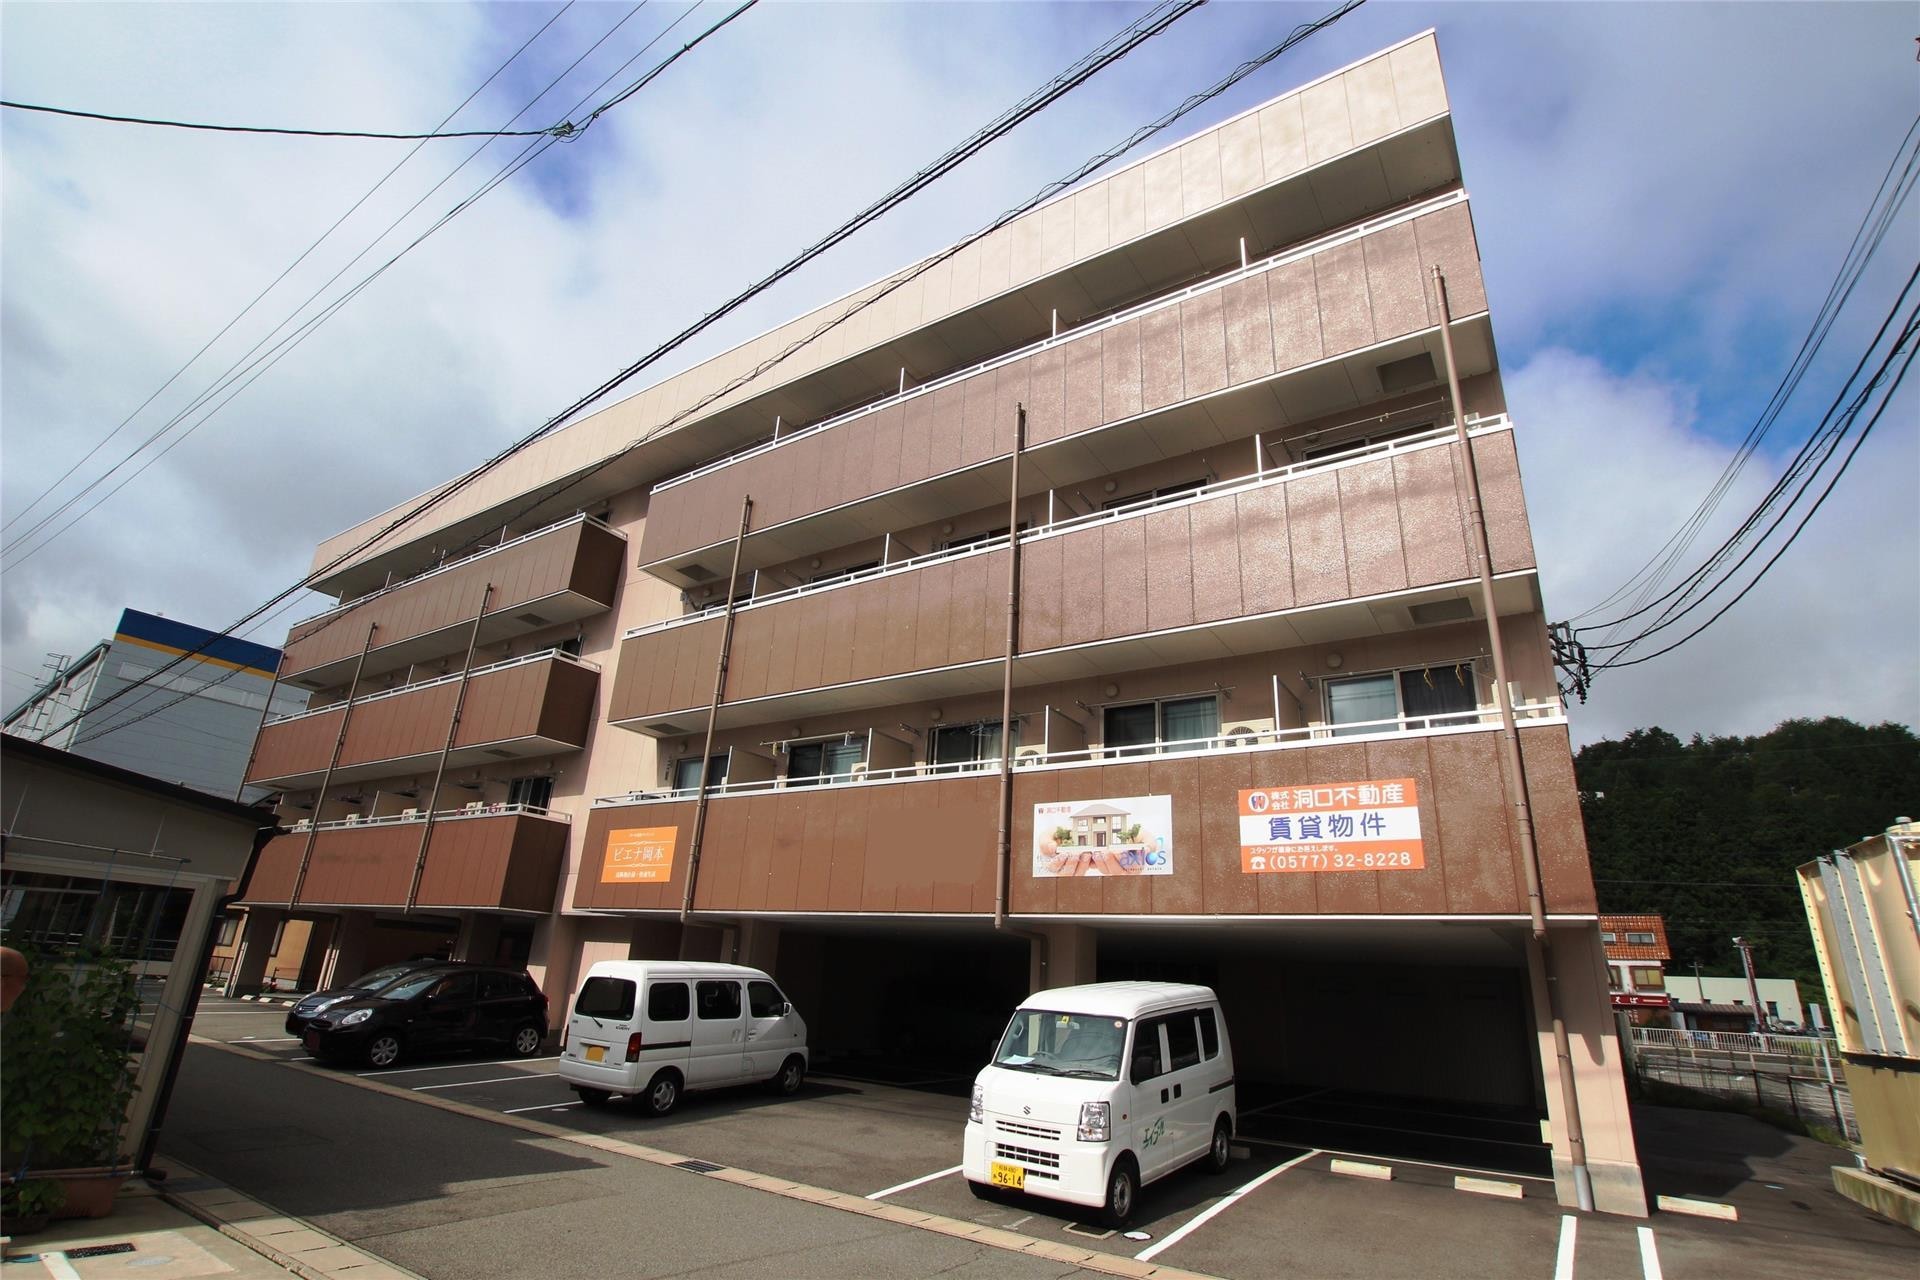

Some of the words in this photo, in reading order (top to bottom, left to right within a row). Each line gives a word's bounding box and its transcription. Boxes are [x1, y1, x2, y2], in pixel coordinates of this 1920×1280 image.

[1272, 801, 1289, 810] 会社
[1293, 784, 1404, 809] 洞口不動産
[1269, 812, 1386, 840] 賃貸物件
